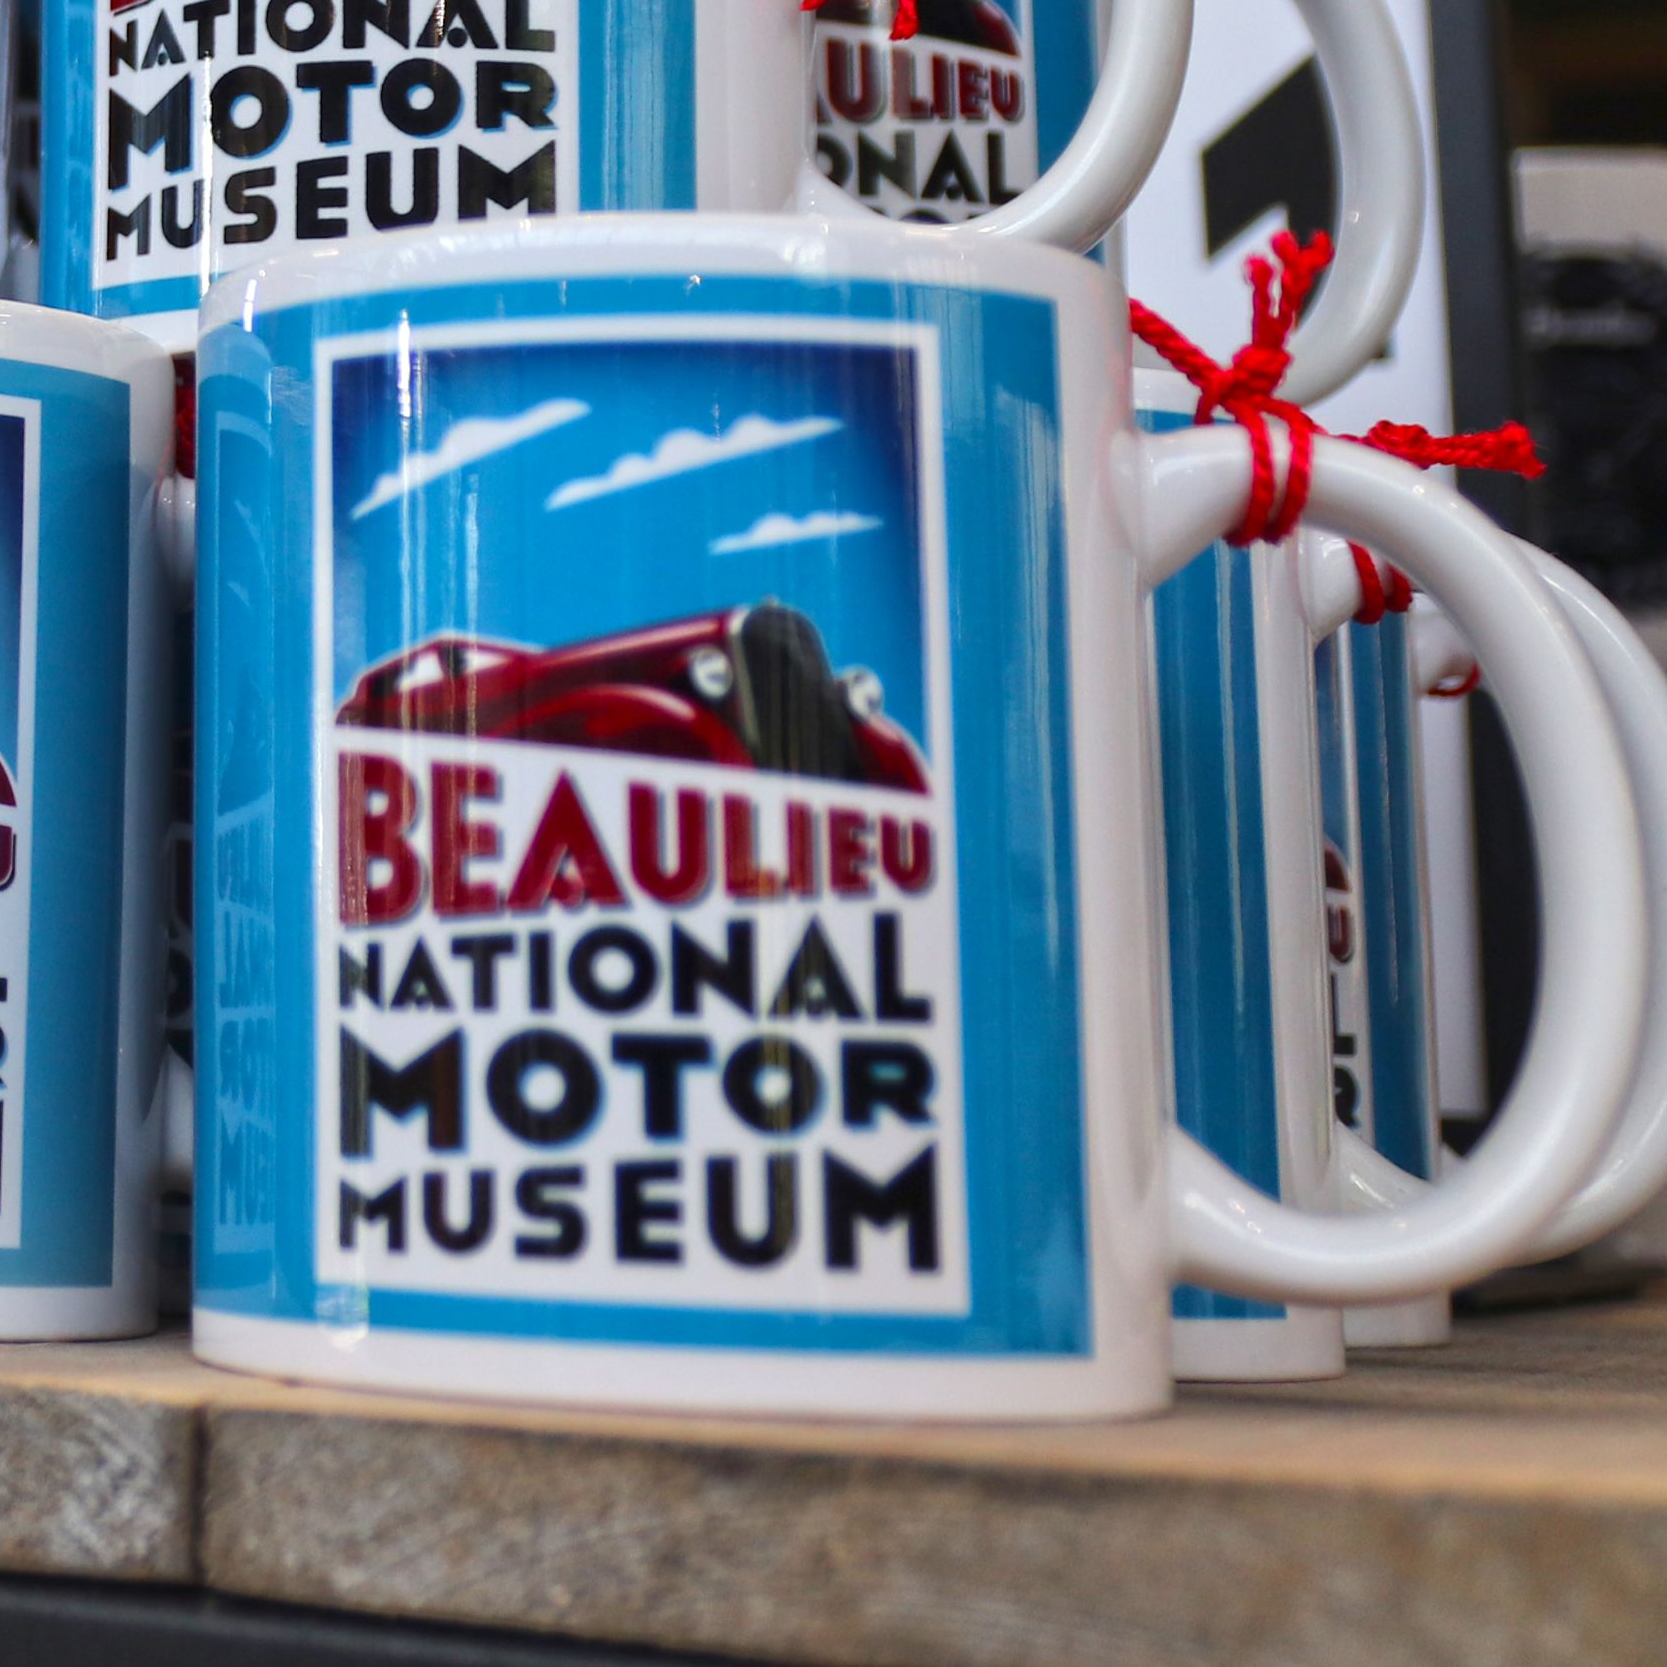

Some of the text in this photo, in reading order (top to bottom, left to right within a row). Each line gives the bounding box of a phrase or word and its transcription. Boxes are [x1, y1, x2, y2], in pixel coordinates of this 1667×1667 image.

[108, 58, 559, 193] MOTOR
[816, 37, 1025, 125] ULIEU
[106, 139, 556, 261] MUSEUM
[338, 750, 936, 928] BEAULIEU
[338, 911, 932, 1024] NATIONAL
[338, 1023, 938, 1161] MOTOR
[338, 1141, 940, 1275] MUSEUM
